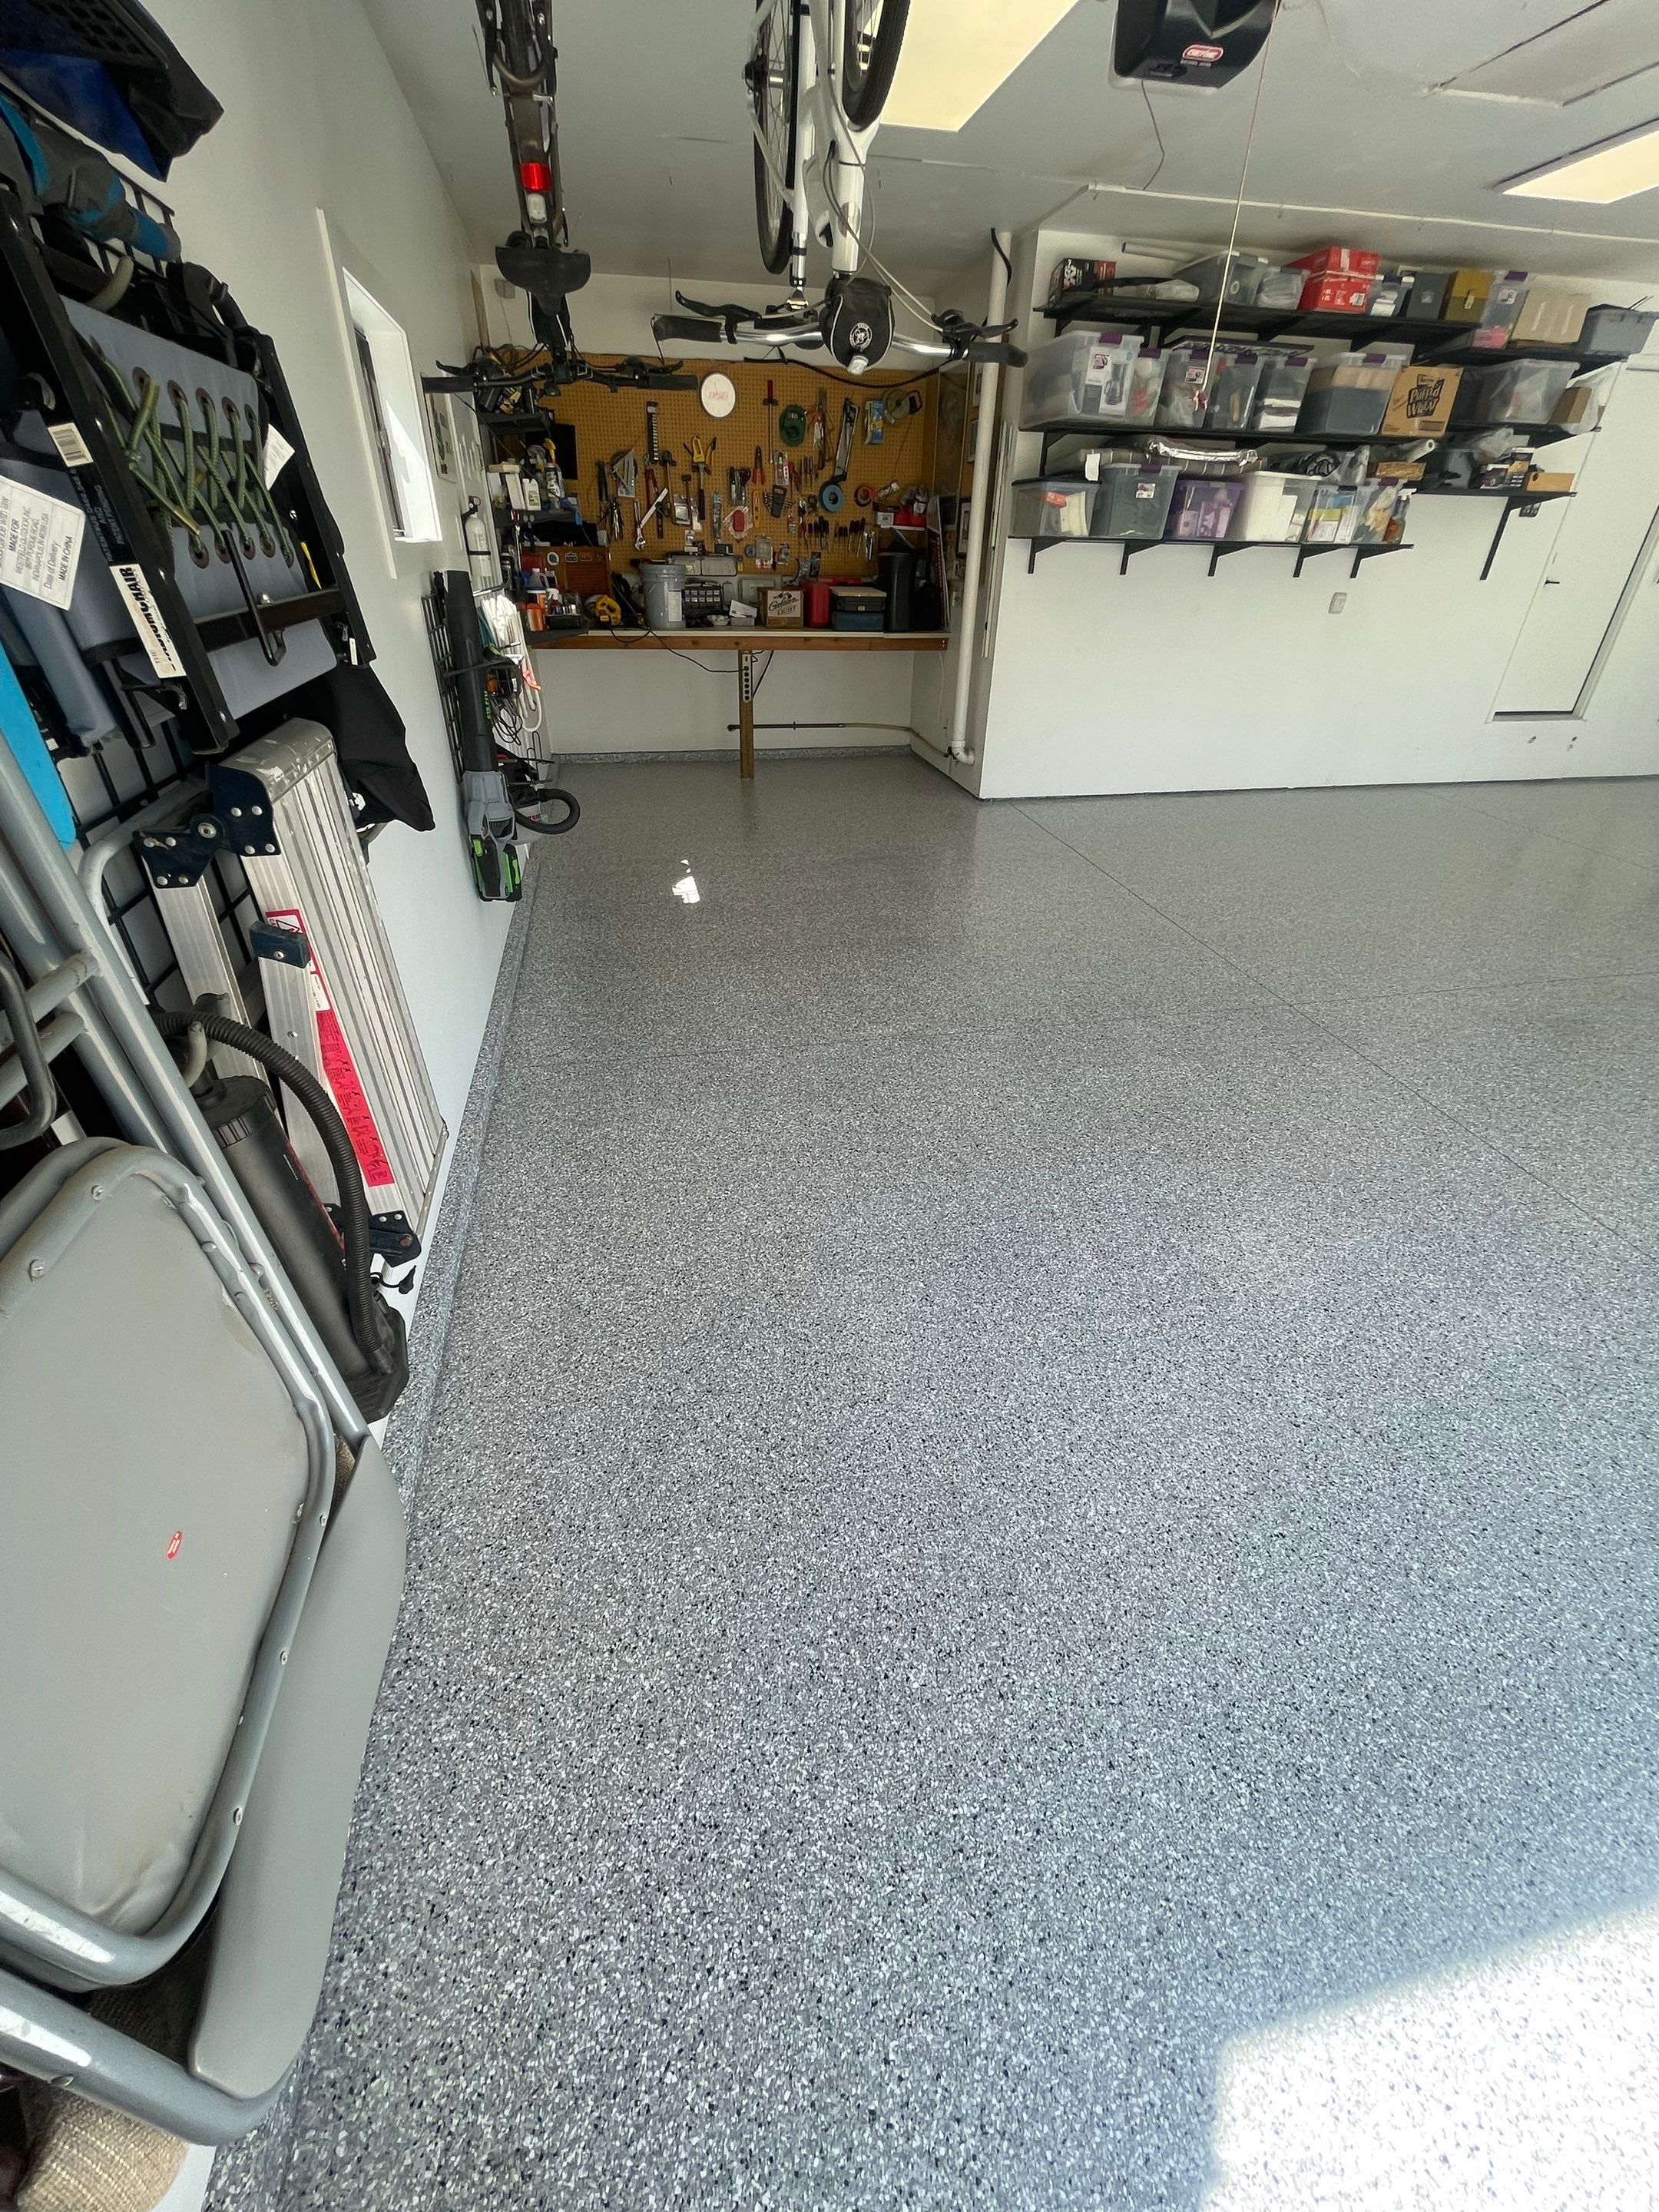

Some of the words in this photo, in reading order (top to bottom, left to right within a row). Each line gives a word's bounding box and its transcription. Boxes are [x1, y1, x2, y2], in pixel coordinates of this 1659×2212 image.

[48, 540, 61, 567] Delivery
[58, 562, 68, 581] MADE
[65, 536, 73, 555] CHINA
[44, 572, 53, 589] Date
